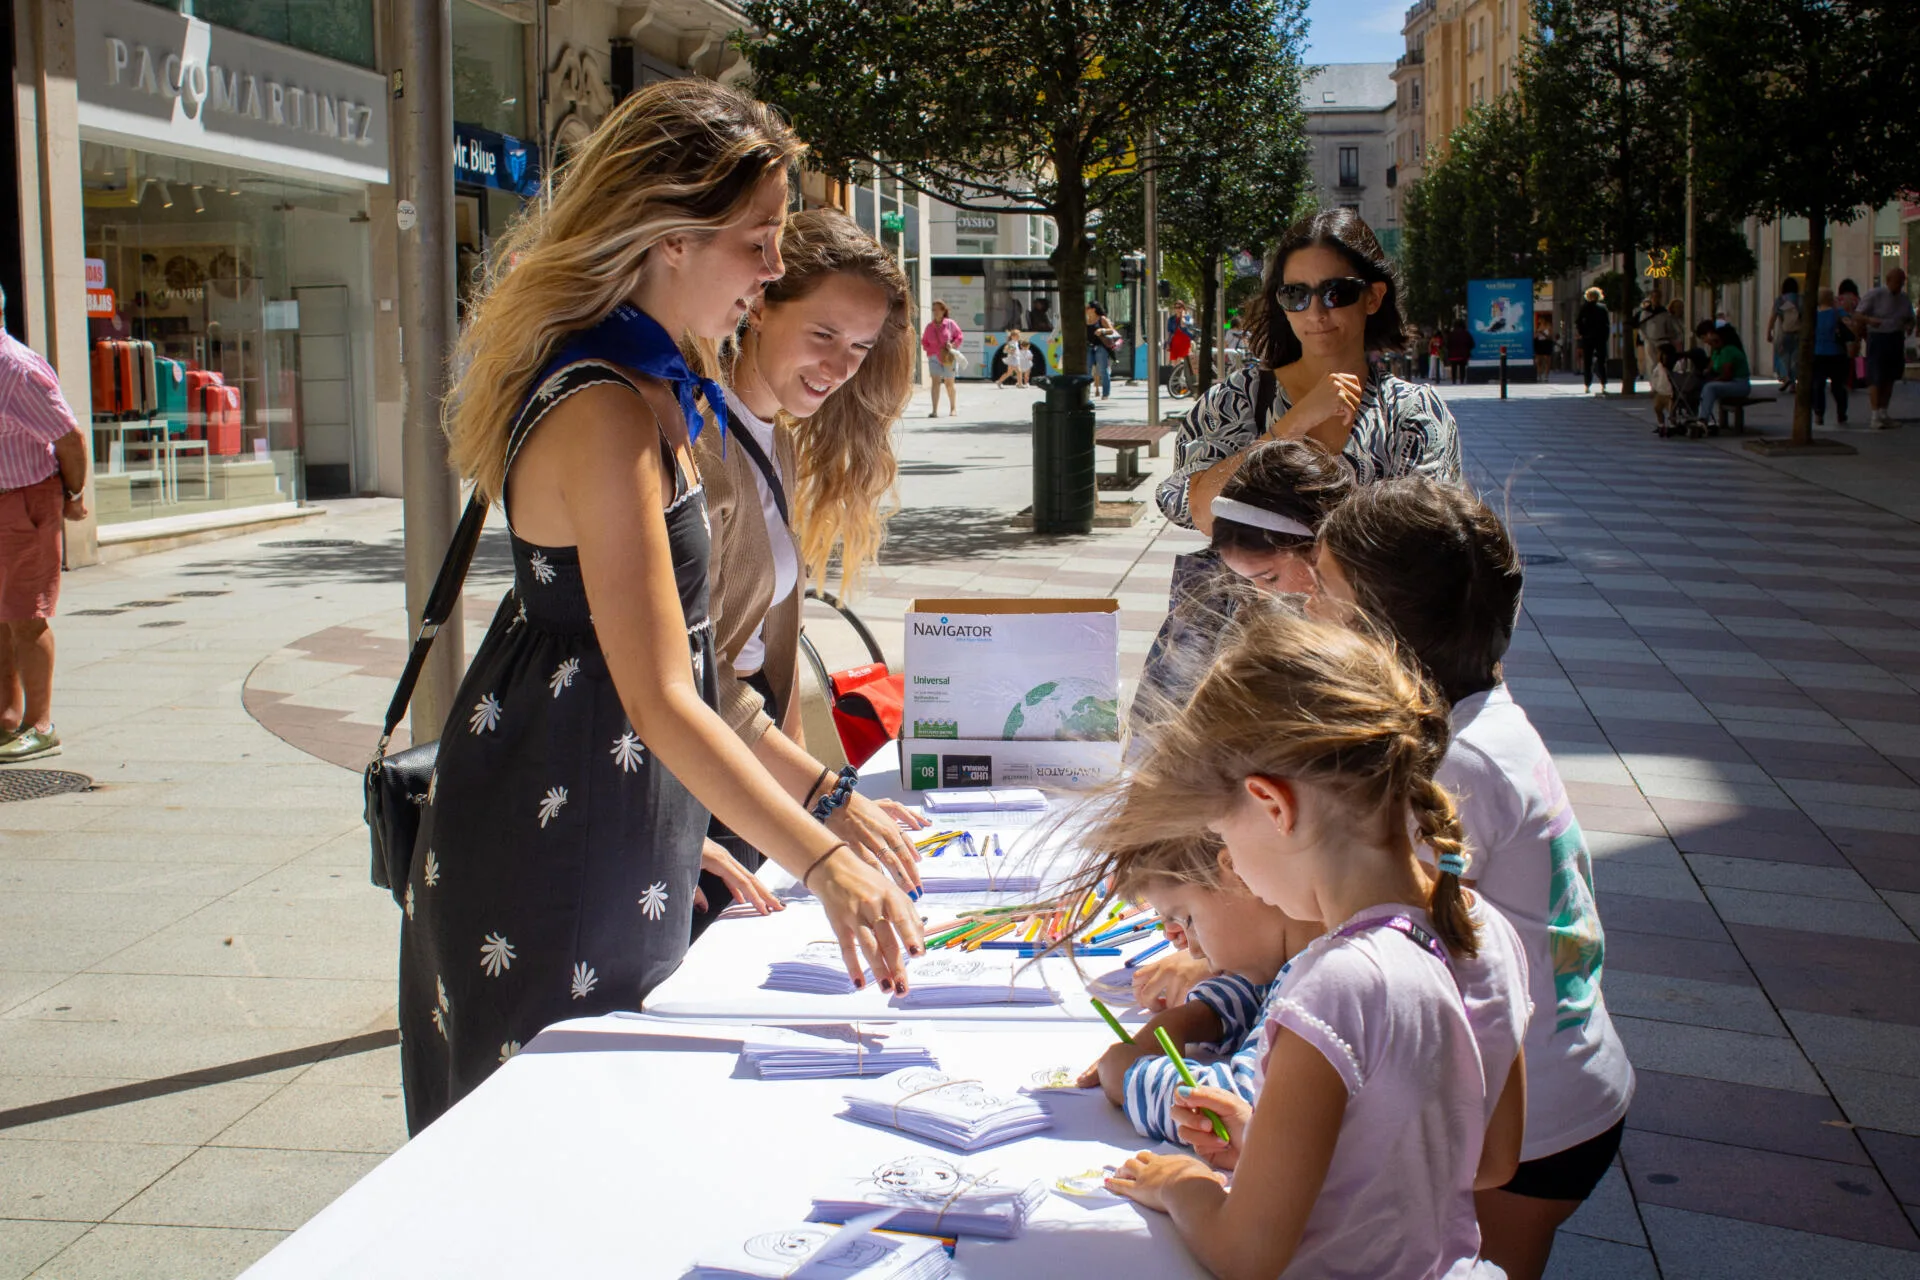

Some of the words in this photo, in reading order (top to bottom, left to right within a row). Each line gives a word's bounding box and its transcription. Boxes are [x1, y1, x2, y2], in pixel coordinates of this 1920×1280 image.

[470, 139, 496, 175] Blue
[957, 216, 996, 229] OYSHO
[914, 622, 992, 637] NAVIGATOR
[914, 675, 950, 685] Universal
[921, 766, 935, 778] 80
[971, 771, 989, 781] UHD
